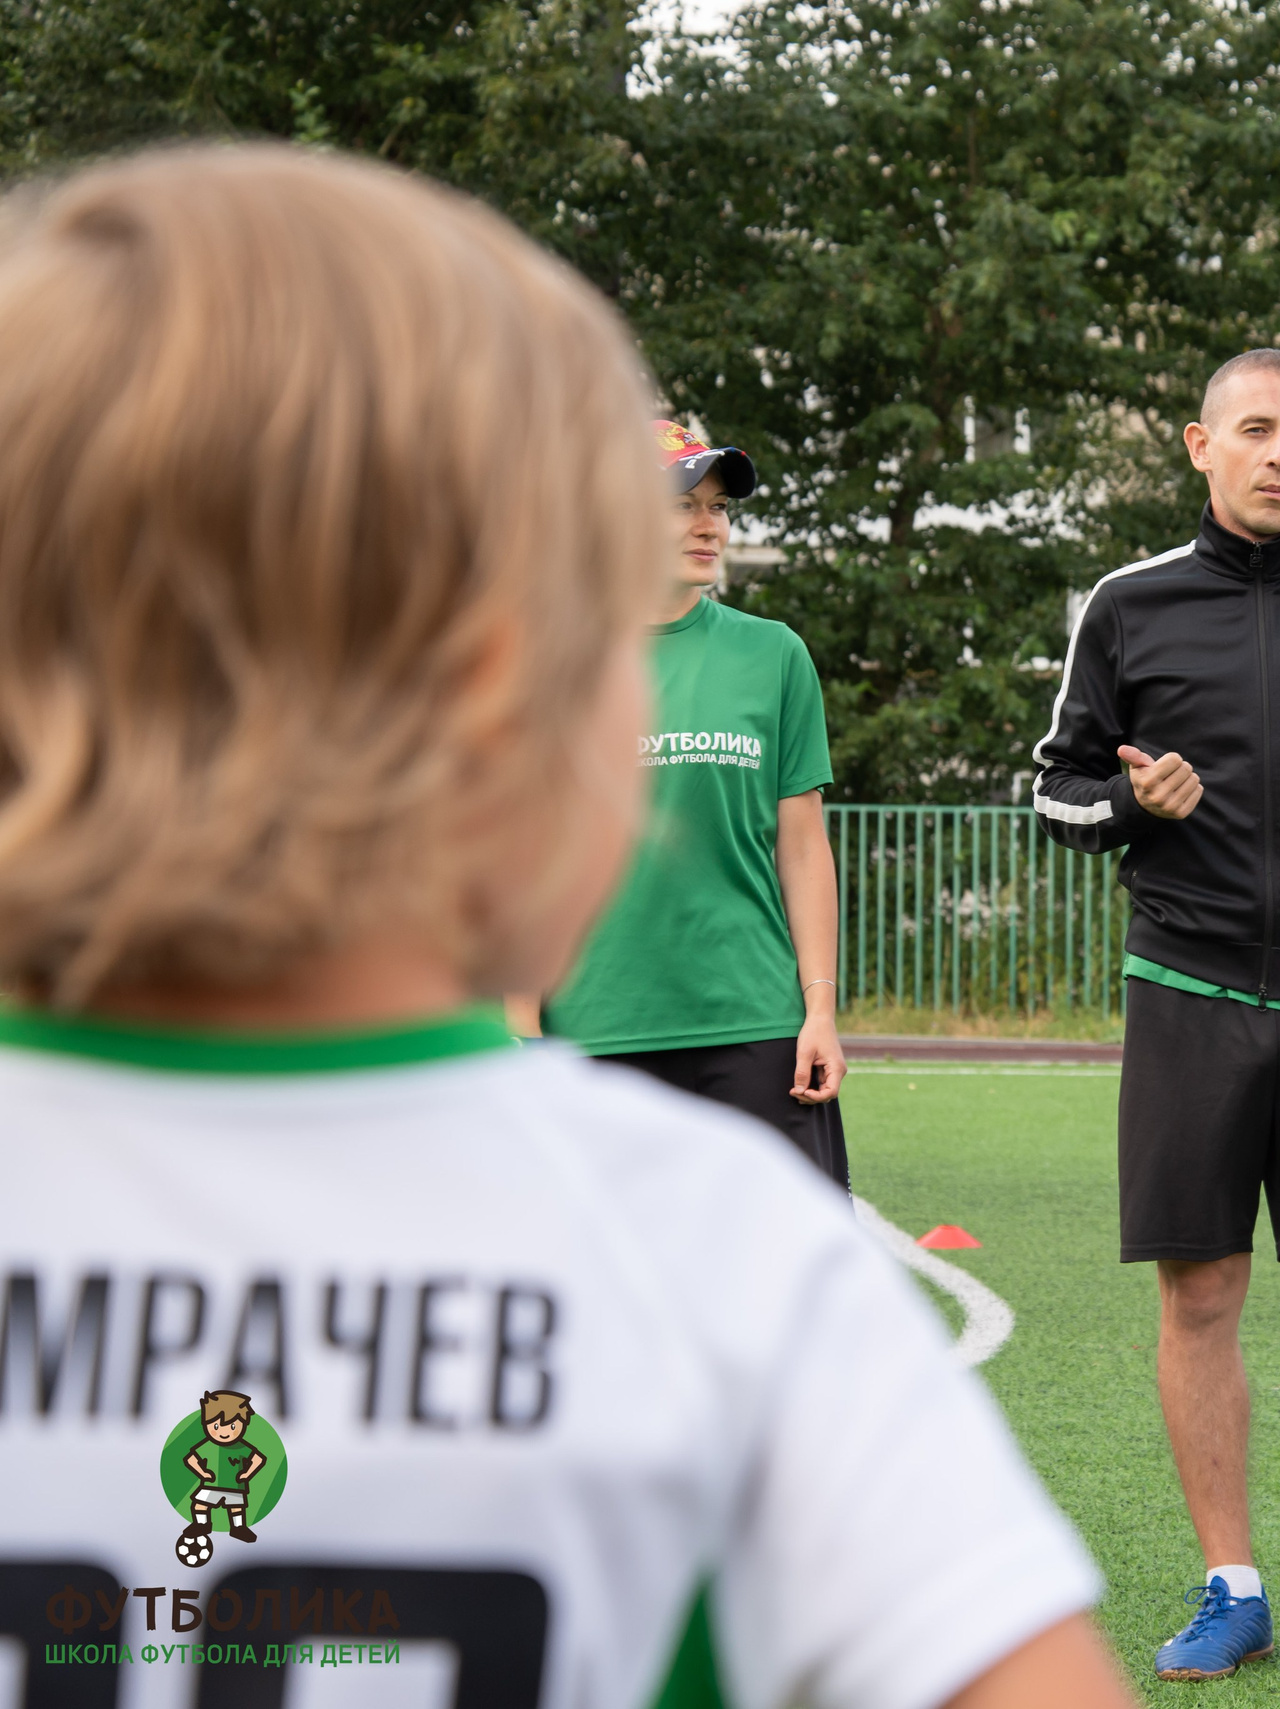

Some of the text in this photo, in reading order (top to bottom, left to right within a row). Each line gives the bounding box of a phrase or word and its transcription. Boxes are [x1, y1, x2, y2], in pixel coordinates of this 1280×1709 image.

[669, 753, 717, 765] ФУТБОЛА
[718, 754, 737, 765] ДЛЯ
[738, 756, 760, 770] ДЕТЕЙ
[0, 1268, 560, 1432] МРАЧЕВ
